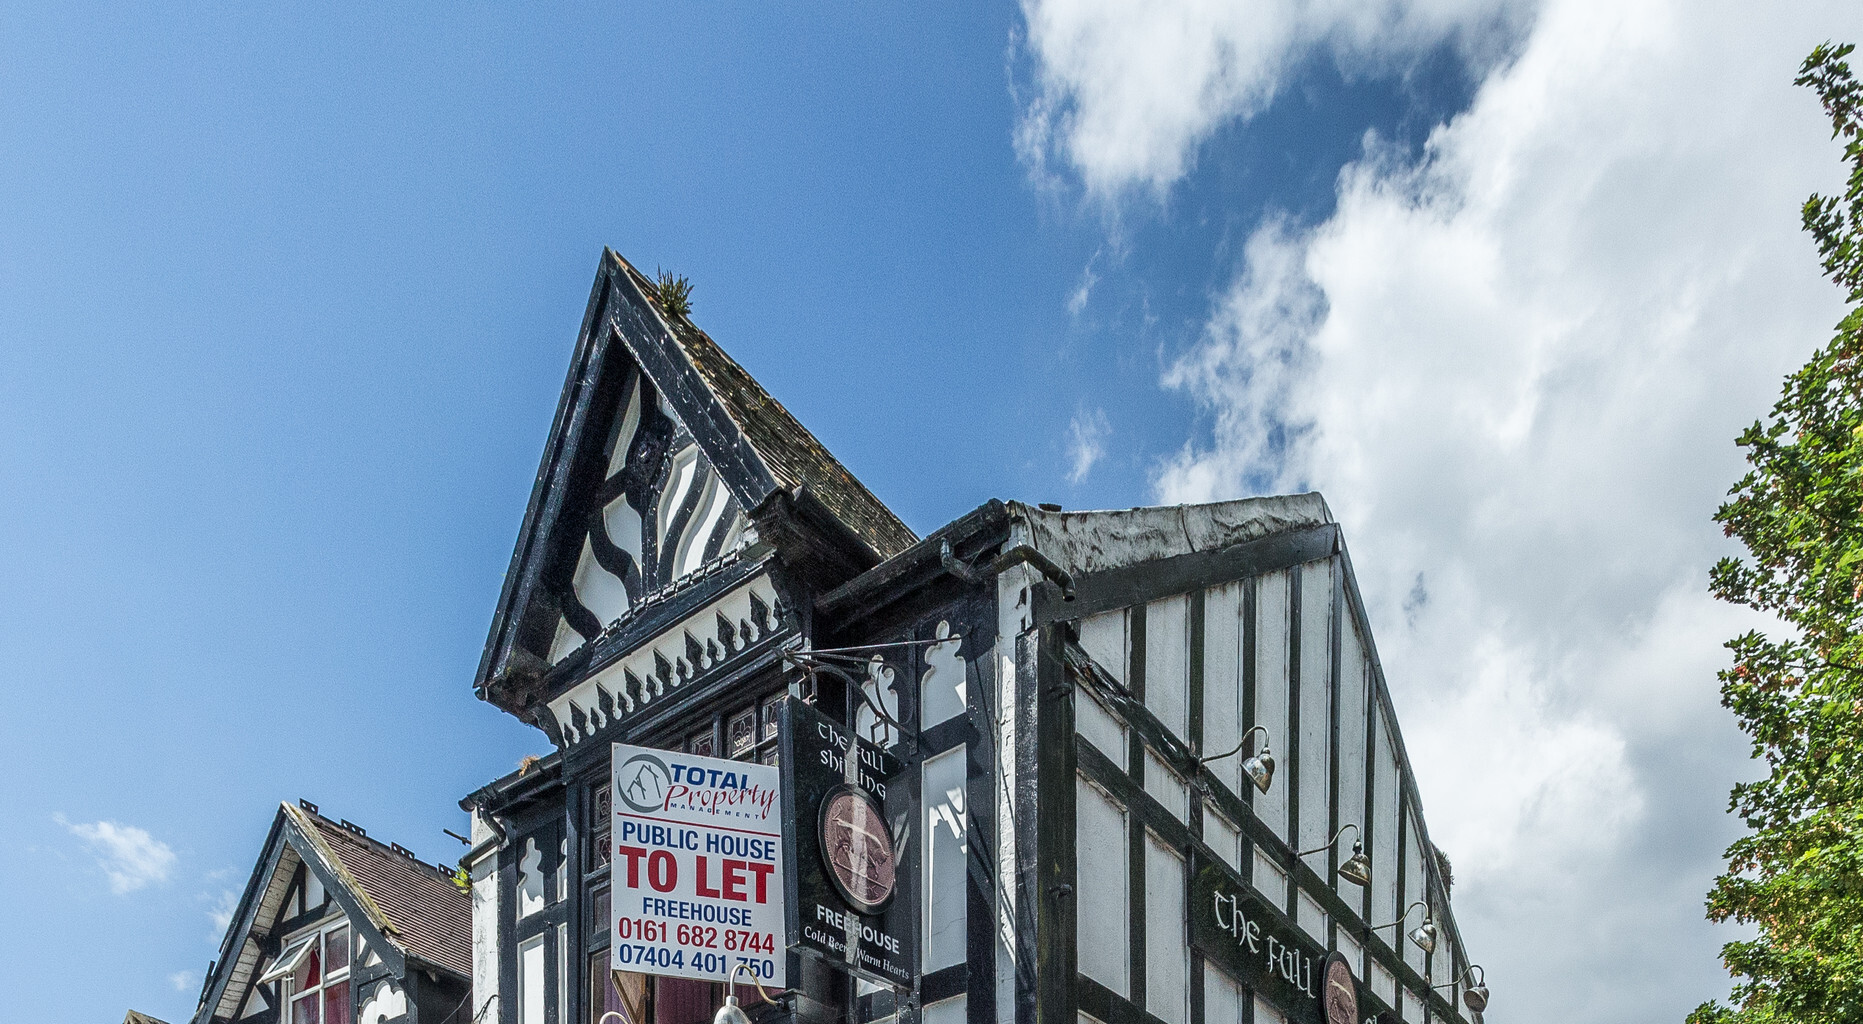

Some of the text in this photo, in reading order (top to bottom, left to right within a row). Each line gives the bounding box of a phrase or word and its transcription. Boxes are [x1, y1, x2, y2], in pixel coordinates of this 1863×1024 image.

[671, 763, 748, 791] TOTAL
[664, 784, 779, 820] Property
[670, 803, 760, 820] MANAGEMENT
[622, 821, 775, 861] PUBLIC HOUSE
[619, 845, 775, 904] TO LET
[643, 897, 752, 926] FREEHOUSE
[816, 904, 900, 955] FREEHOUSE
[619, 917, 775, 955] 0161 682 8744
[804, 926, 826, 944] Cold
[856, 947, 881, 967] Warm
[882, 959, 910, 980] Hearts
[619, 944, 774, 979] 07404 401 750
